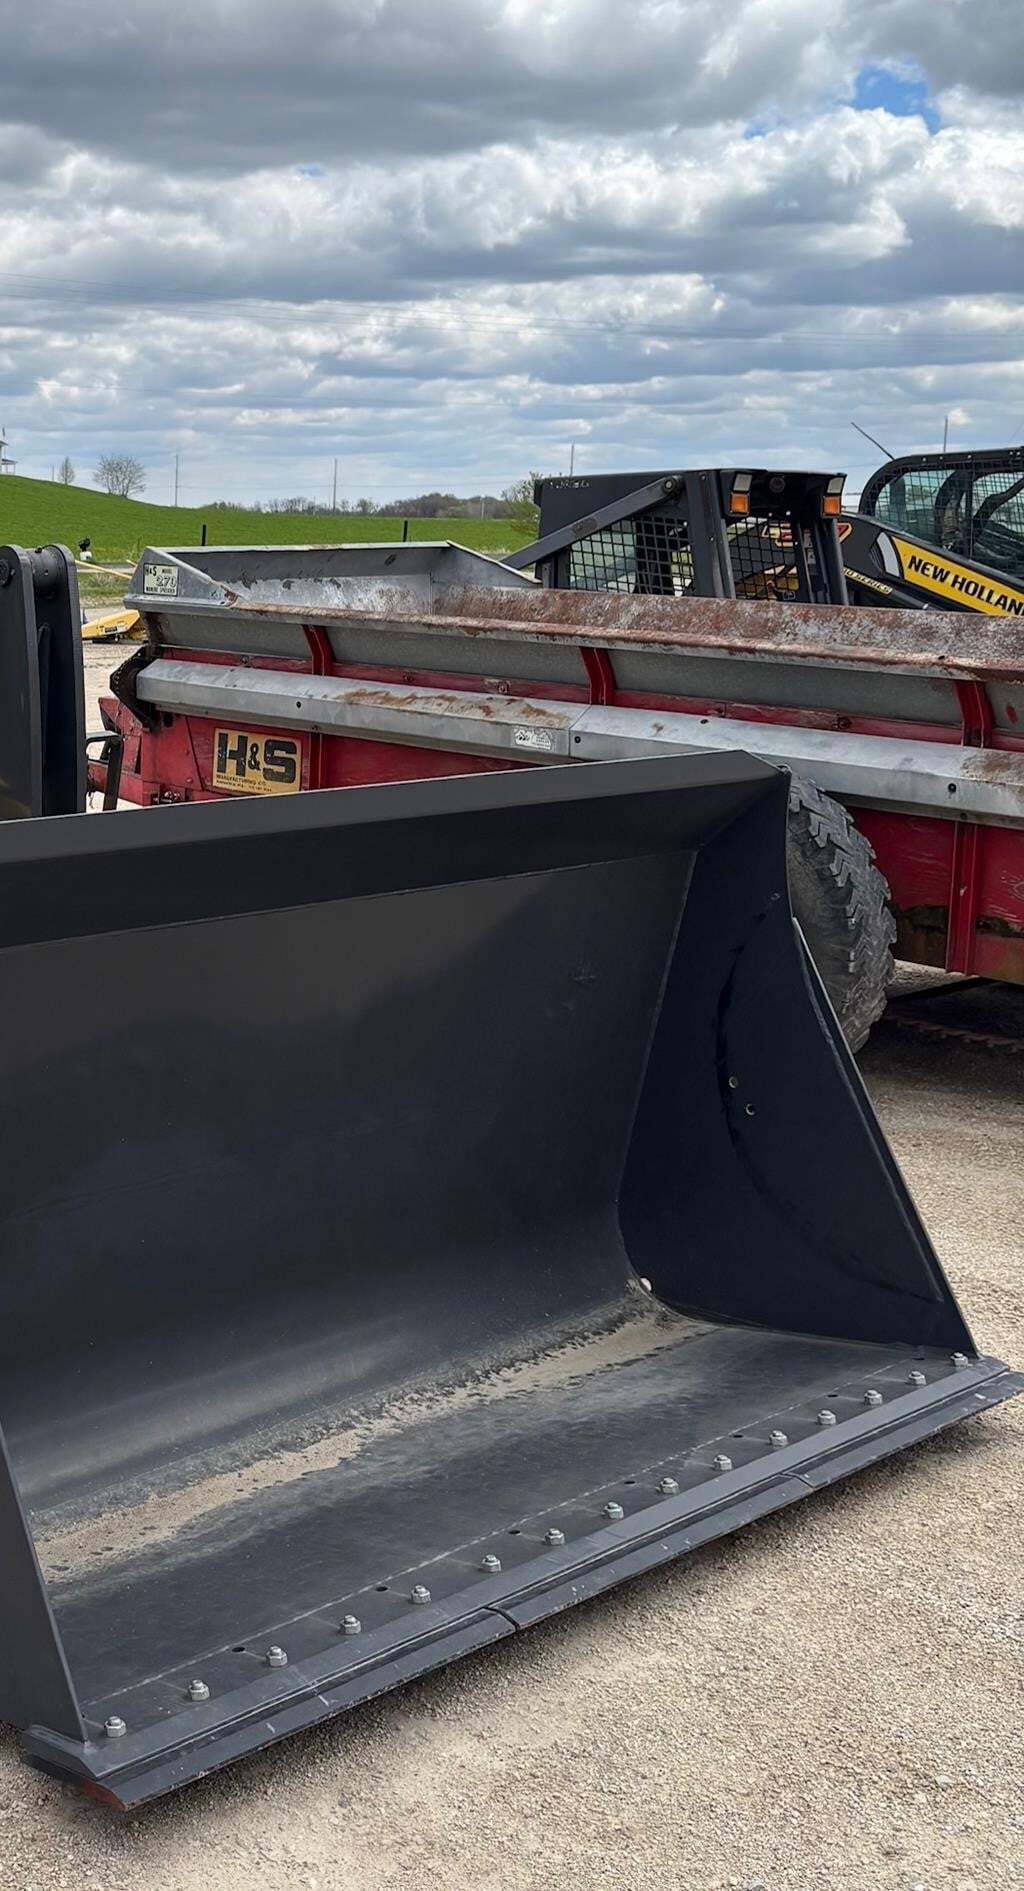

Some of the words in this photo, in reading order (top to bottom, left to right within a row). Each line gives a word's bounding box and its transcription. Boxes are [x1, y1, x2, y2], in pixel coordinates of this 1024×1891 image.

[908, 555, 951, 583] NEW
[951, 574, 1024, 616] HOLLAN
[216, 732, 298, 785] H&S
